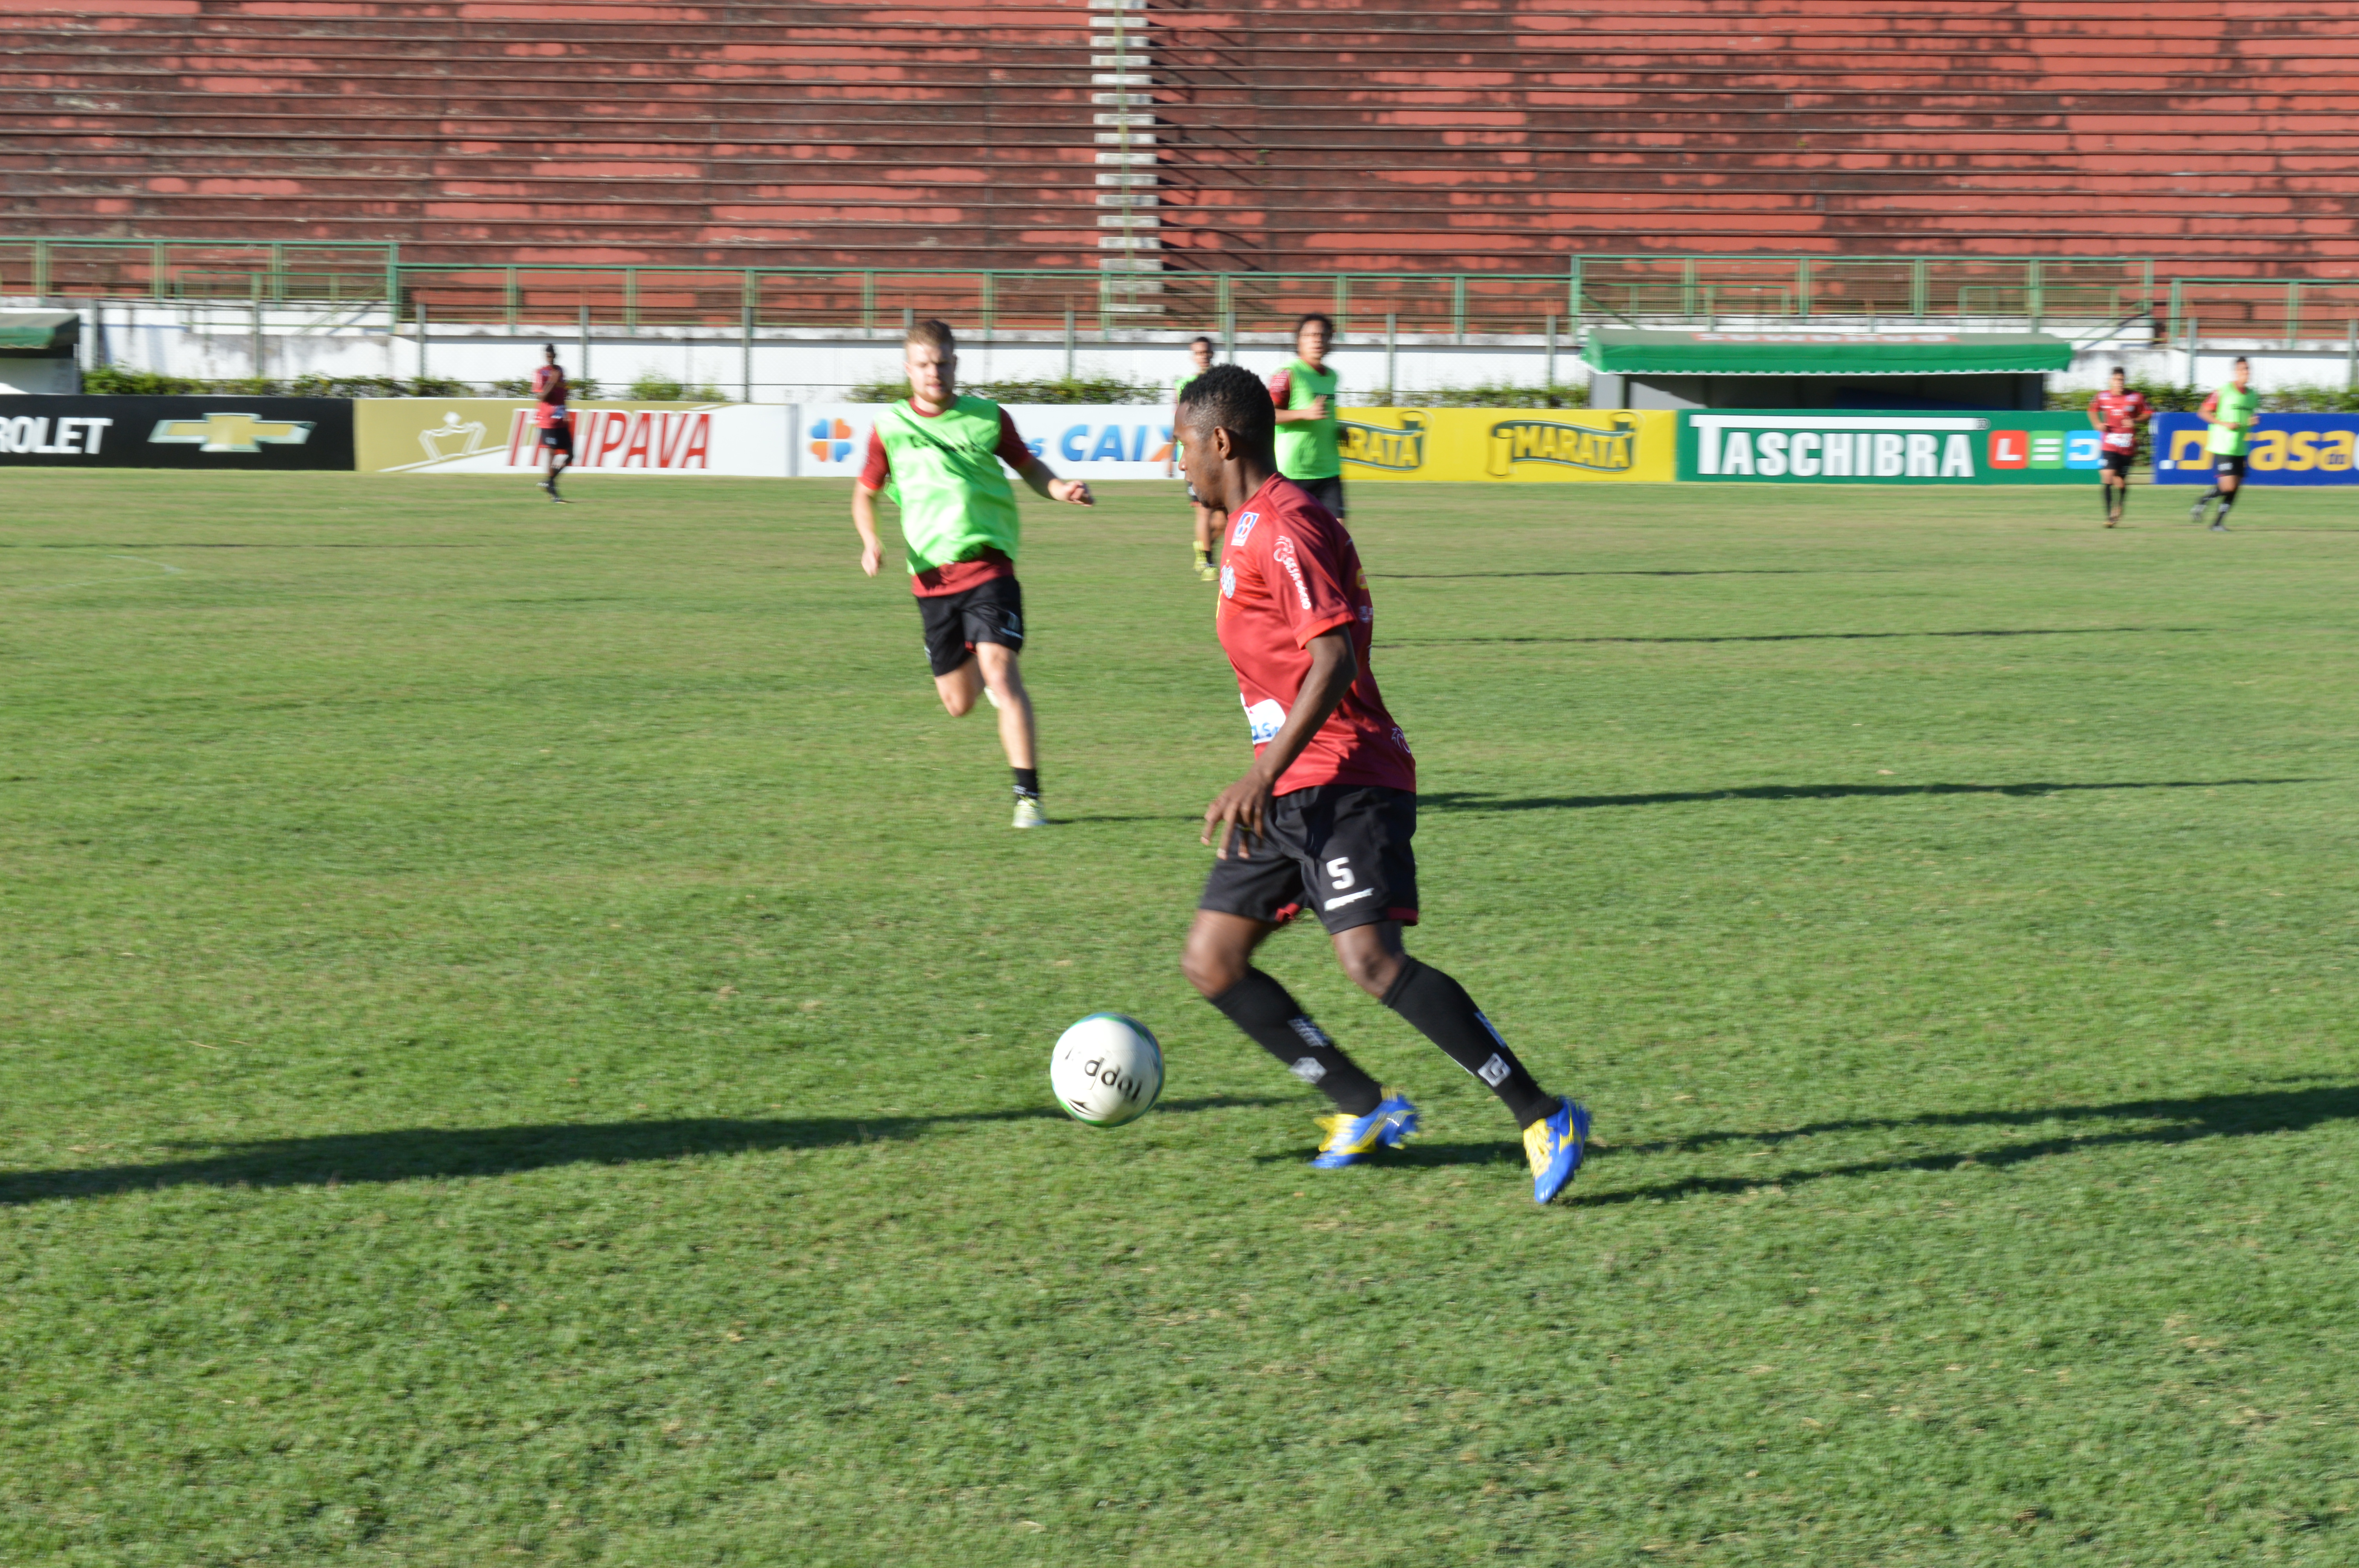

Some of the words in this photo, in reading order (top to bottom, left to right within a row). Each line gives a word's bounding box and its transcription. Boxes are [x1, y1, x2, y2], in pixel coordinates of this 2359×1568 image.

[1689, 414, 1976, 477] TASCHIBRA
[1995, 438, 2102, 461] LED
[1326, 857, 1355, 890] 5
